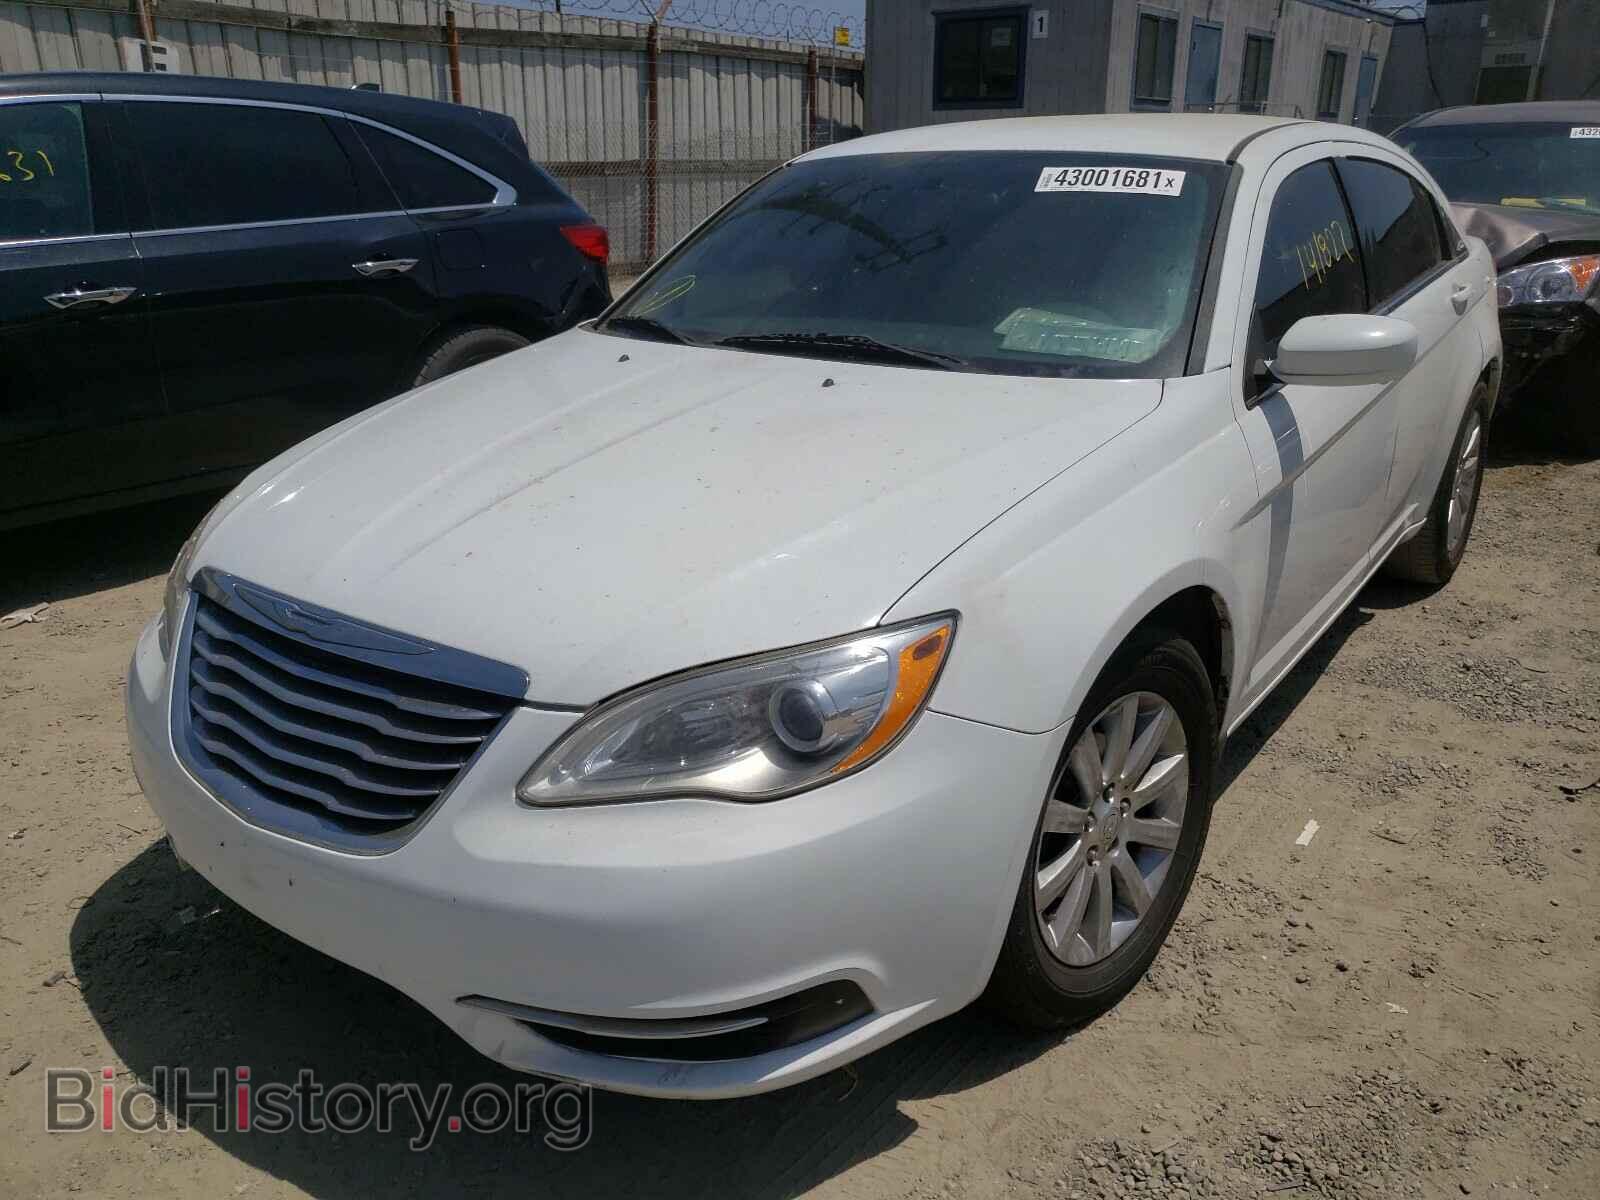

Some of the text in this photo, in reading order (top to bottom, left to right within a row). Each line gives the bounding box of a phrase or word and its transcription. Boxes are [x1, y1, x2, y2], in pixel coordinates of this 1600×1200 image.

[1037, 15, 1044, 33] 1
[1577, 128, 1600, 136] 432
[1054, 168, 1162, 189] 43001681
